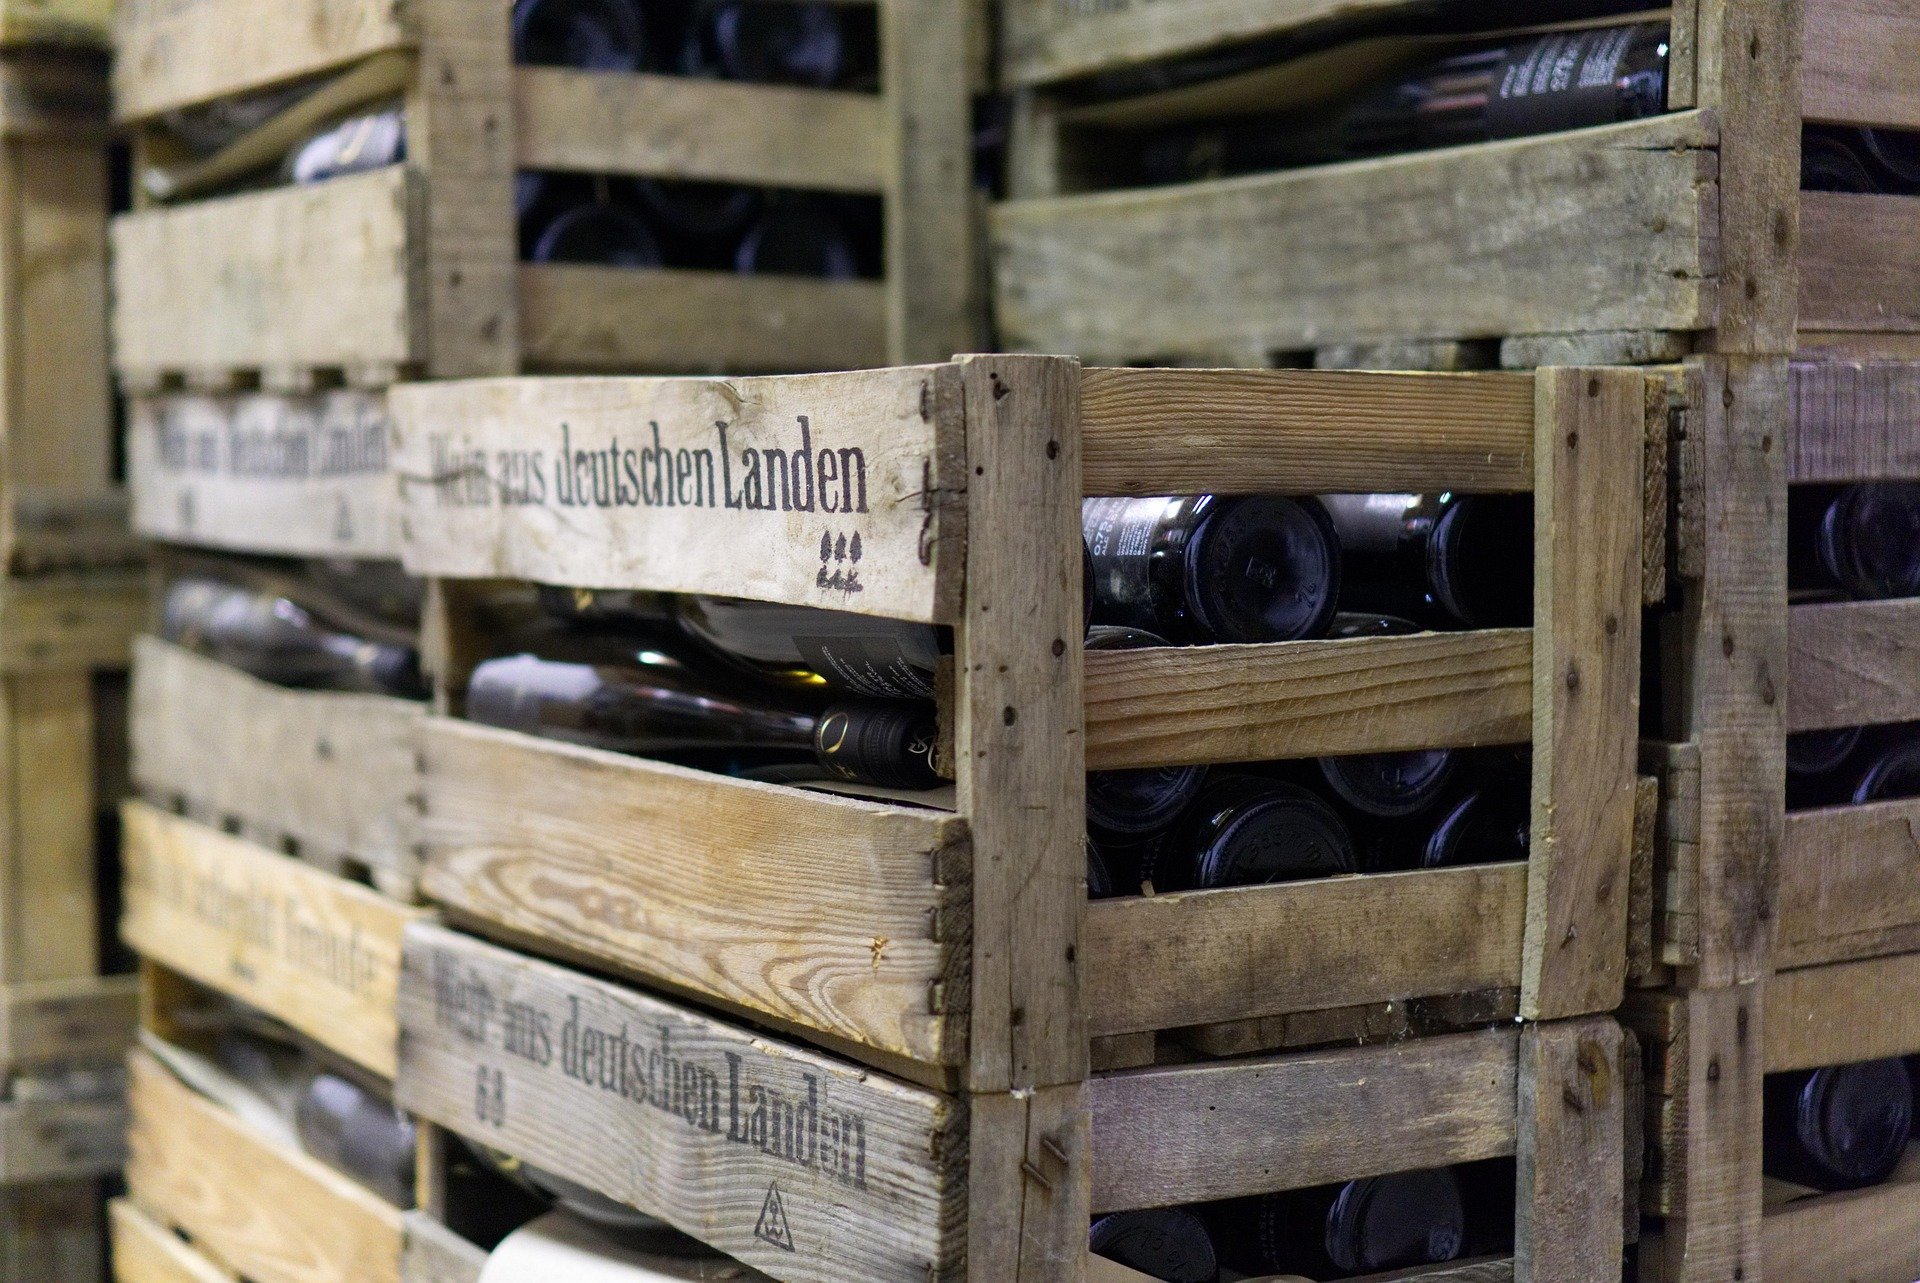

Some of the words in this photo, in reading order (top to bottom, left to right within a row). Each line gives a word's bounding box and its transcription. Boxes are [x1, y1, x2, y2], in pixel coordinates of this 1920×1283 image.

[496, 449, 546, 506] aus
[555, 420, 716, 509] deutschen
[714, 415, 869, 513] Landen
[502, 1001, 551, 1069] aus
[561, 994, 722, 1134] deutschen
[725, 1051, 867, 1192] Landen
